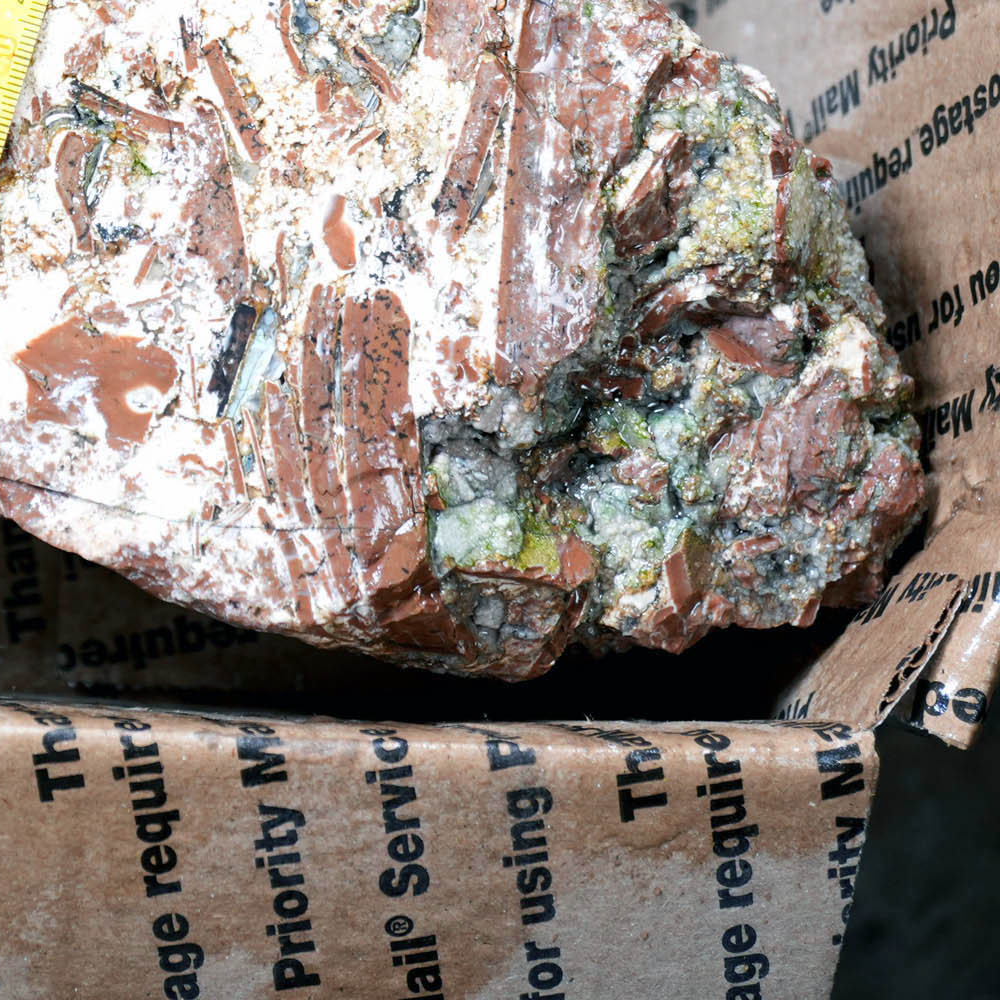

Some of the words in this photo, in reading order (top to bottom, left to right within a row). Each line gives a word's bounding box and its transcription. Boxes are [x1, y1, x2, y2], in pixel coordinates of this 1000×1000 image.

[927, 283, 966, 336] for
[358, 728, 431, 898] Service
[502, 786, 557, 926] using
[255, 800, 321, 992] Priority
